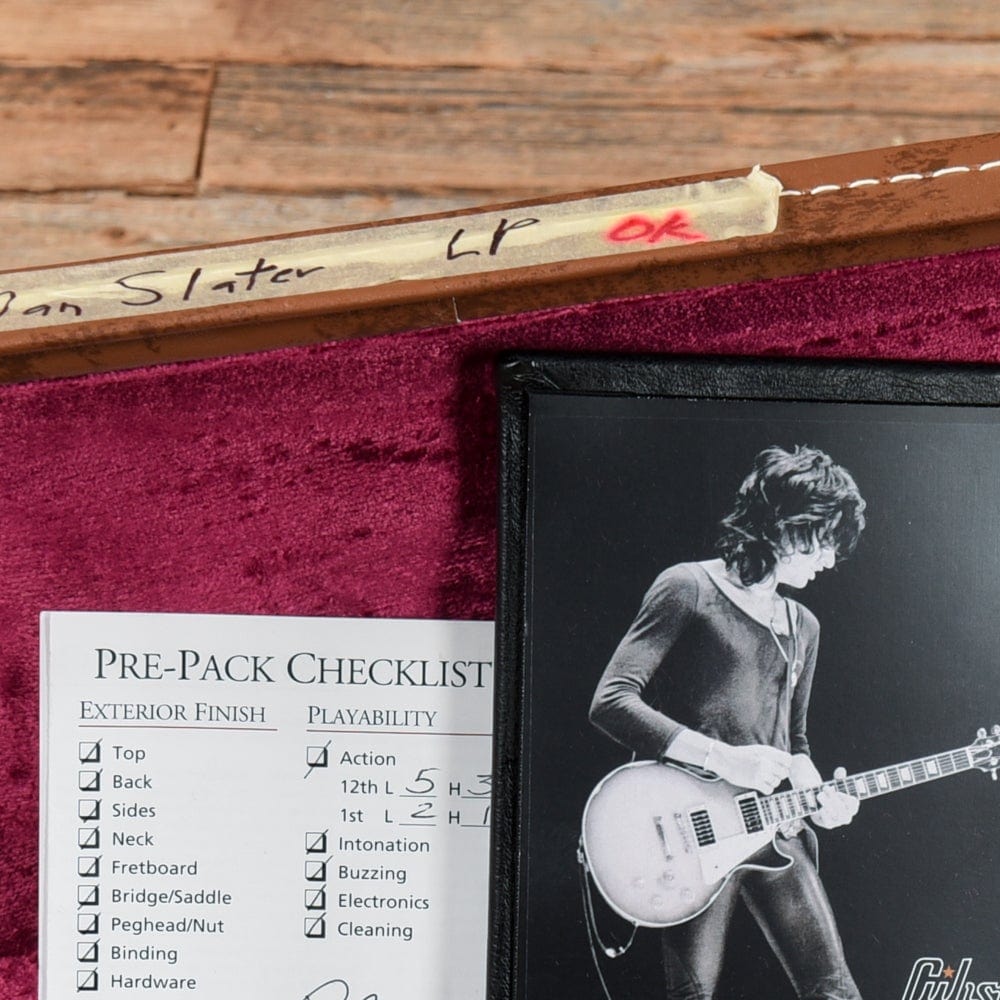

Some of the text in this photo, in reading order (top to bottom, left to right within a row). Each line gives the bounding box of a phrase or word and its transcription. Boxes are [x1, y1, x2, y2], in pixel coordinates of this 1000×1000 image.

[112, 745, 146, 764] Top
[339, 750, 396, 766] Action
[112, 774, 153, 789] Back
[341, 779, 378, 795] 12th
[385, 780, 394, 795] L
[449, 782, 460, 796] H
[112, 802, 156, 818] Sides
[340, 808, 364, 823] 1st
[384, 809, 394, 824] L
[448, 811, 460, 825] H
[112, 831, 154, 847] Neck
[339, 836, 430, 853] Intonation
[112, 859, 198, 876] Fretboard
[338, 865, 407, 885] Buzzing
[111, 888, 232, 908] Bridge/Saddle
[338, 892, 430, 910] Electronics
[111, 916, 225, 936] Peghead/Nut
[337, 921, 413, 942] Cleaning
[111, 945, 178, 965] Binding
[111, 974, 197, 990] Hardware
